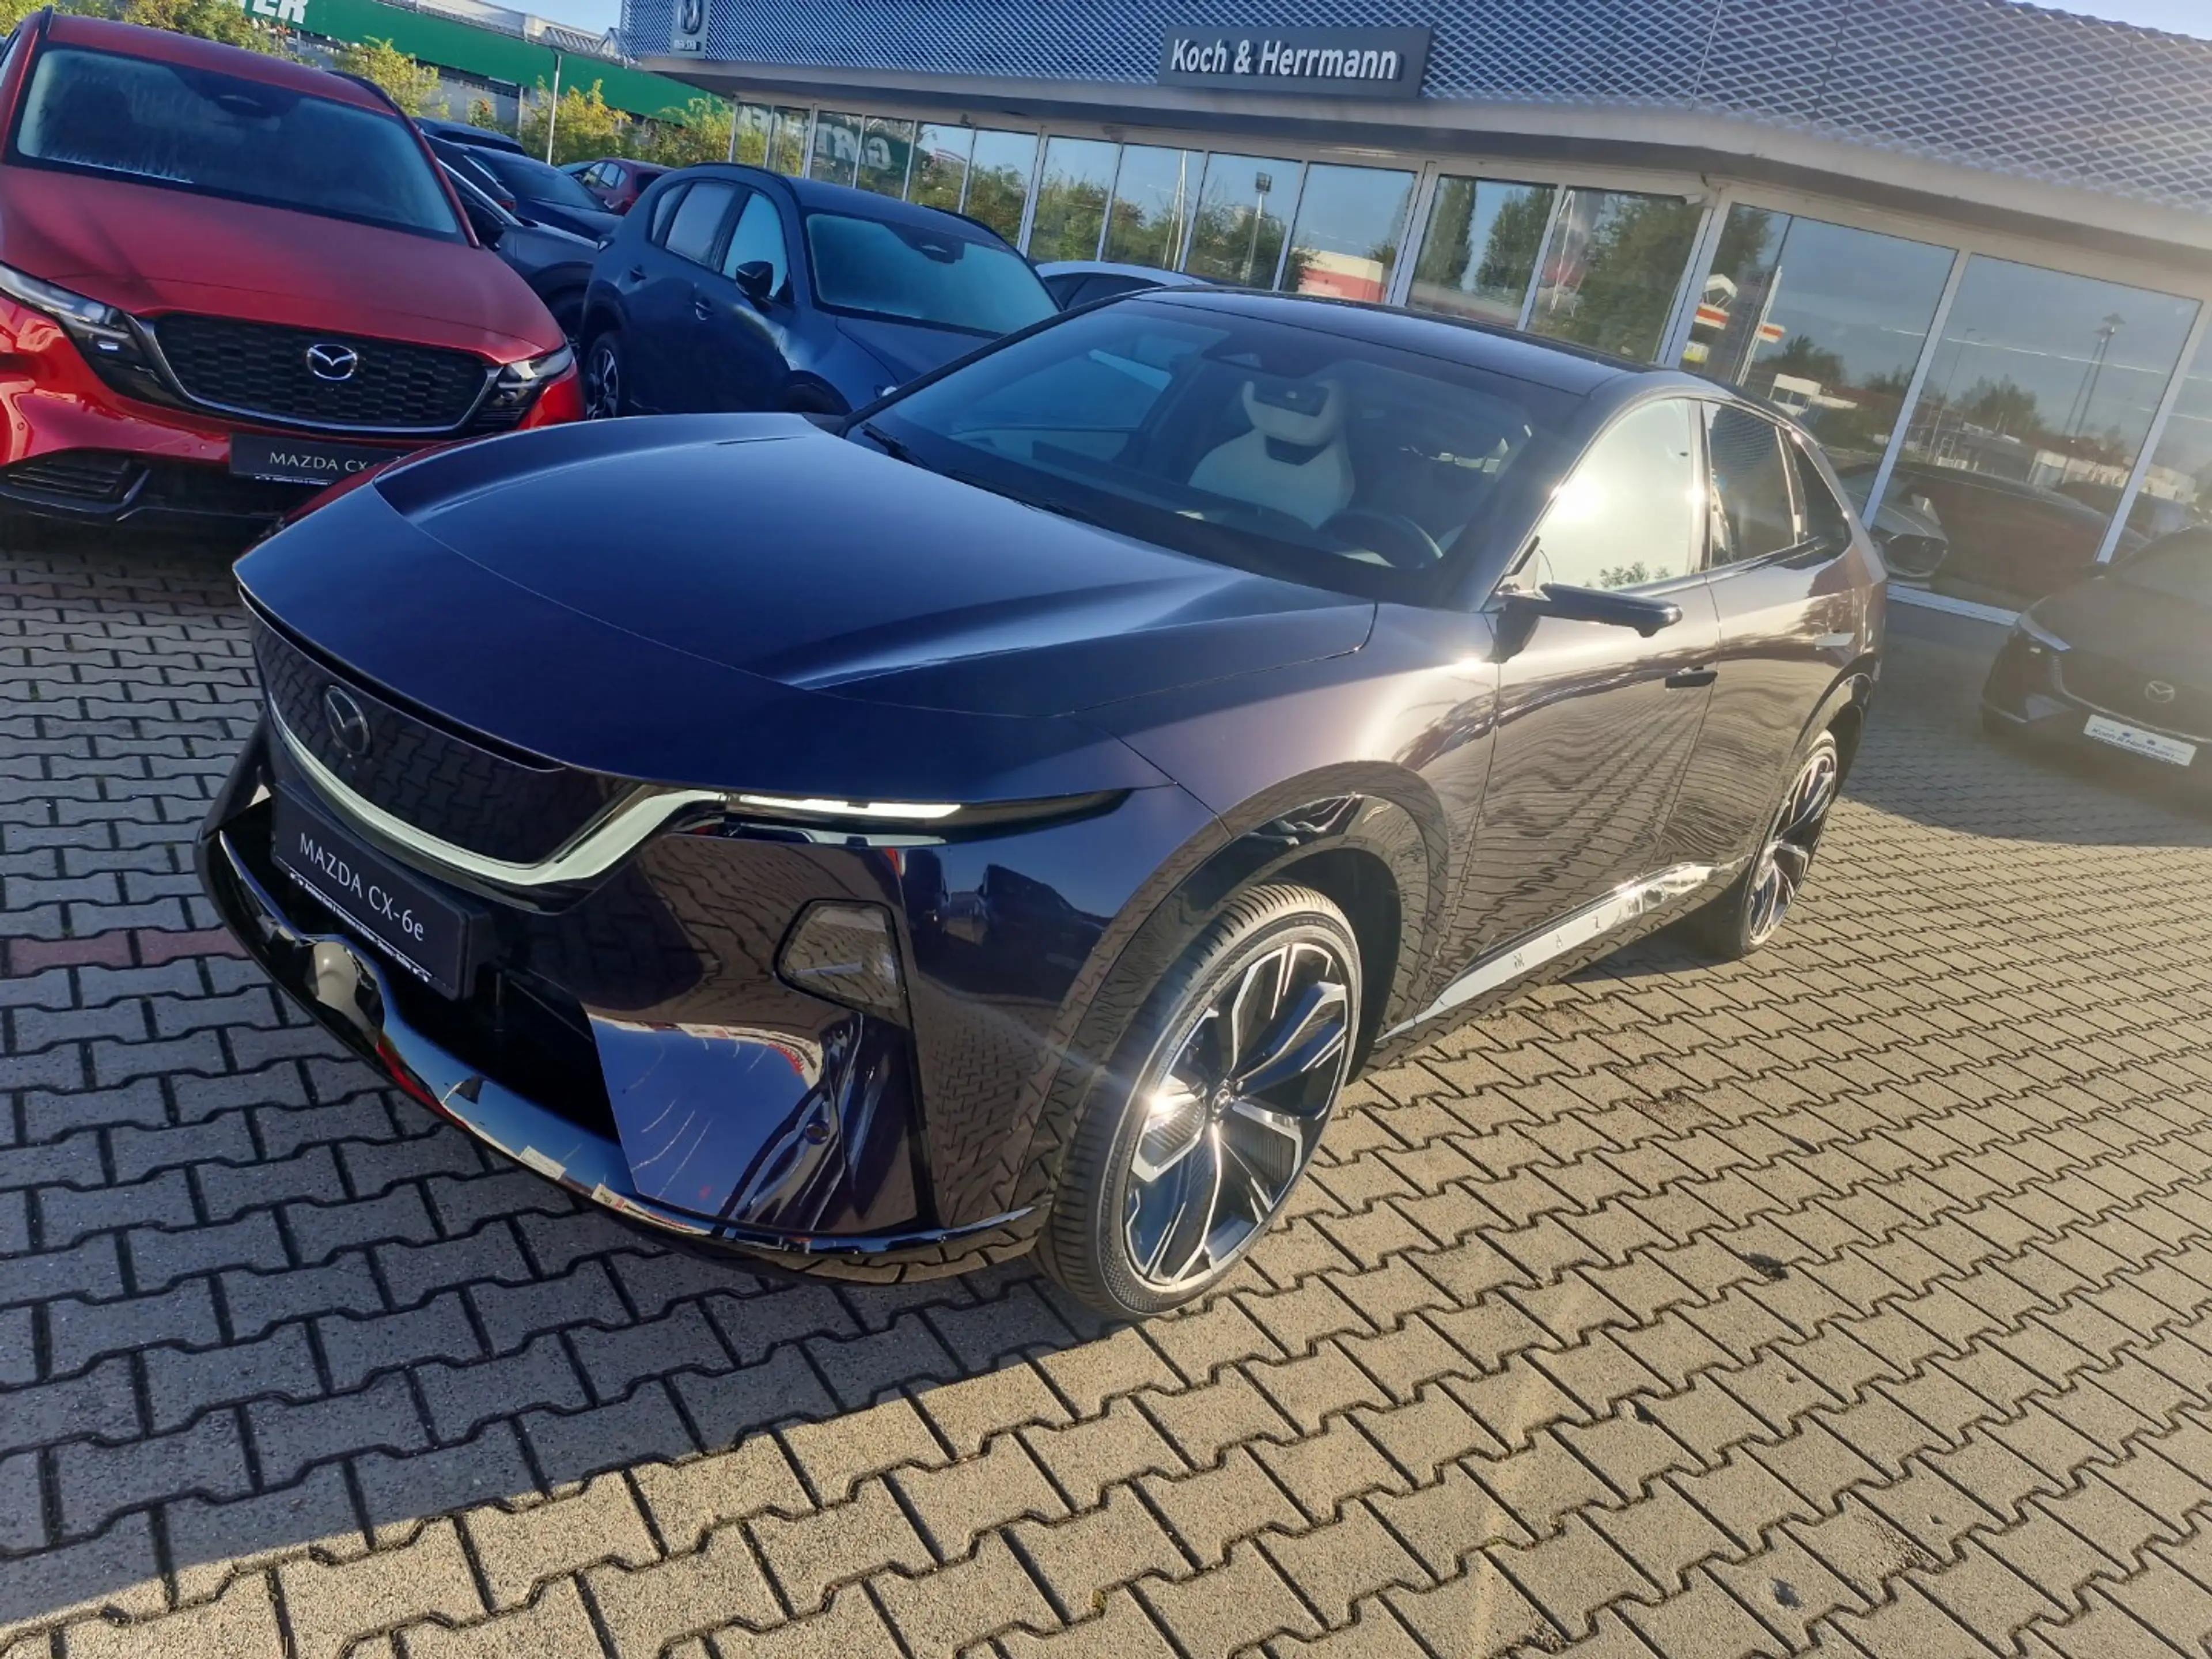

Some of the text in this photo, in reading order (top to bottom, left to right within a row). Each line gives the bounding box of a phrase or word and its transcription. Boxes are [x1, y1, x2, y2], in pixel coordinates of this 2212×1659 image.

[1170, 39, 1396, 79] Koch & Herrmann
[269, 451, 338, 471] MAZDA
[300, 832, 424, 942] MAZDA CX-6e
